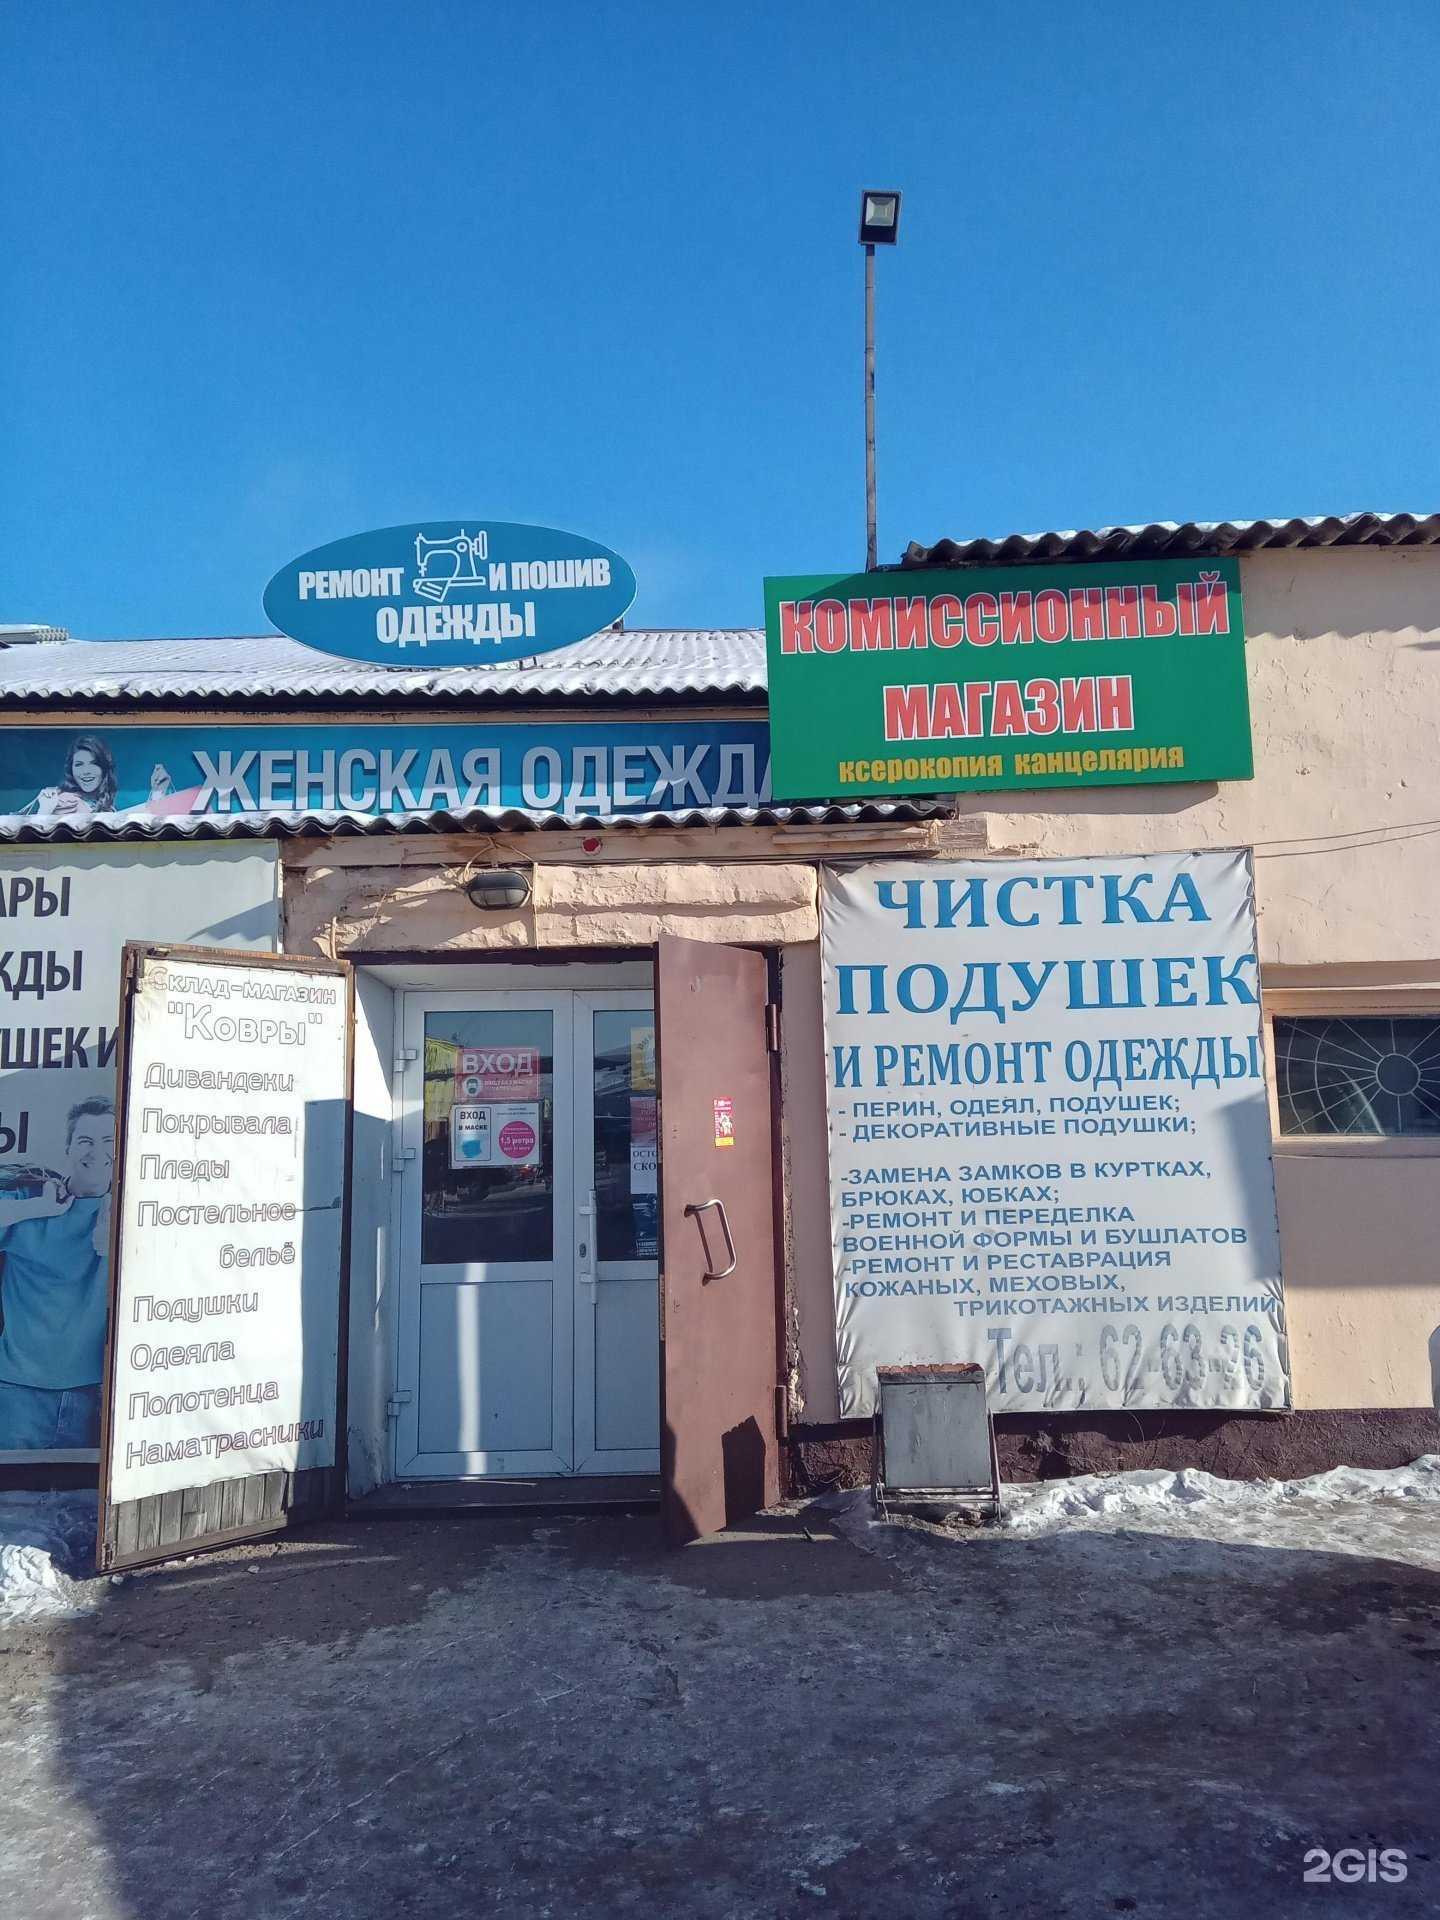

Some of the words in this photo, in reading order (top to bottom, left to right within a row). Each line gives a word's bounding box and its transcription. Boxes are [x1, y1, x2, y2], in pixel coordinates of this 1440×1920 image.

[299, 567, 404, 599] РЕМОНТ
[488, 564, 507, 592] И
[512, 558, 611, 590] ПОШИВ
[376, 602, 536, 648] ОДЕЖДЫ
[778, 570, 1231, 655] КОМИССИОННЫЙ
[882, 675, 1135, 742] МАГАЗИН
[191, 748, 501, 811] ЖЕНСКАЯ
[838, 753, 1003, 784] ксерокопия
[1015, 745, 1185, 777] канцелярия
[873, 872, 1212, 929] ЧИСТКА
[835, 953, 1260, 1025] ПОДУШЕК
[0, 1027, 89, 1069] ШЕК
[833, 1046, 863, 1088] И
[875, 1040, 1052, 1088] РЕМОНТ
[1065, 1035, 1260, 1092] ОДЕЖДЫ
[144, 1062, 294, 1093] Дивандеки
[463, 1053, 533, 1080] ВХОД
[460, 1111, 486, 1120] ВХОД
[853, 1100, 942, 1118] ПЕРИН,
[950, 1097, 1041, 1118] ОДЕЯЛ,
[1050, 1095, 1180, 1114] ПОДУШЕК;
[142, 1108, 292, 1139] Покрывала
[853, 1119, 1056, 1143] ДЕКОРАТИВНЫЕ
[1064, 1117, 1196, 1136] ПОДУШКИ;
[140, 1154, 230, 1182] Пледы
[841, 1166, 951, 1185] -ЗАМЕНА
[959, 1163, 1062, 1181] ЗАМКОВ
[1071, 1163, 1086, 1178] В
[1095, 1161, 1211, 1179] КУРТКАХ,
[841, 1188, 954, 1208] БРЮКАХ,
[961, 1185, 1060, 1204] ЮБКАХ;
[138, 1201, 296, 1227] Постельное
[842, 1211, 953, 1230] -РЕМОНТ
[961, 1210, 976, 1226] И
[985, 1206, 1135, 1227] ПЕРЕДЕЛКА
[220, 1242, 296, 1269] бельё
[842, 1229, 965, 1252] ВОЕННОЙ
[973, 1229, 1071, 1248] ФОРМЫ
[1081, 1230, 1096, 1245] И
[1106, 1228, 1247, 1245] БУШЛАТОВ
[963, 1255, 978, 1271] И
[988, 1251, 1171, 1270] РЕСТАВРАЦИЯ
[846, 1278, 981, 1298] КОЖАНЫХ,
[990, 1274, 1126, 1293] МЕХОВЫХ,
[133, 1292, 258, 1323] Подушки
[954, 1296, 1149, 1316] ТРИКОТАЖНЫХ
[1158, 1293, 1276, 1314] ИЗДЕЛИЙ
[130, 1340, 235, 1372] Одеяла
[128, 1381, 280, 1420] Полотенца
[126, 1419, 324, 1469] Наматрасники
